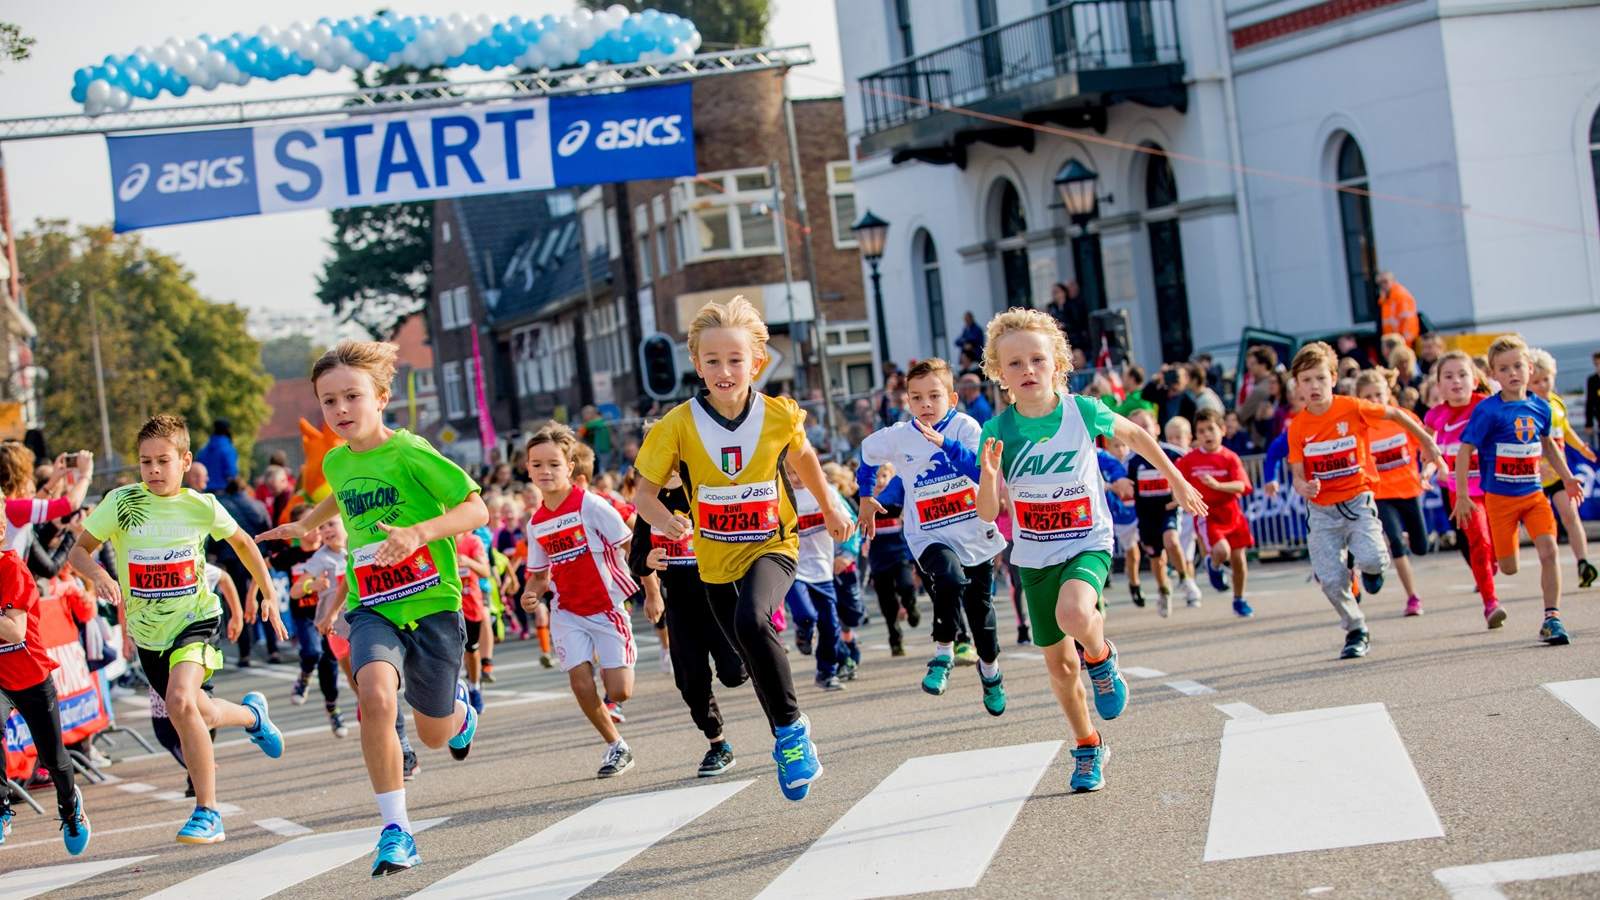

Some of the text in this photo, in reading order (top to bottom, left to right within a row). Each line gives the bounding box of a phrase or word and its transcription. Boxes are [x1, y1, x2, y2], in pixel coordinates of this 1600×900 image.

[595, 114, 685, 151] asics
[273, 108, 535, 203] START
[156, 155, 247, 194] asics
[1016, 450, 1079, 478] AVZ
[753, 486, 774, 497] asics
[1063, 485, 1086, 496] asics
[344, 486, 398, 517] TRIATLON
[924, 500, 962, 522] K3941
[708, 512, 760, 531] K2734
[1024, 511, 1072, 530] K2526
[738, 534, 767, 542] DAMLOOP
[1050, 532, 1079, 540] DAMLOOP
[173, 549, 192, 559] asics
[135, 571, 180, 589] K2676
[365, 565, 415, 595] K2843
[387, 593, 398, 602] TOT
[398, 585, 426, 600] DAMLOOP
